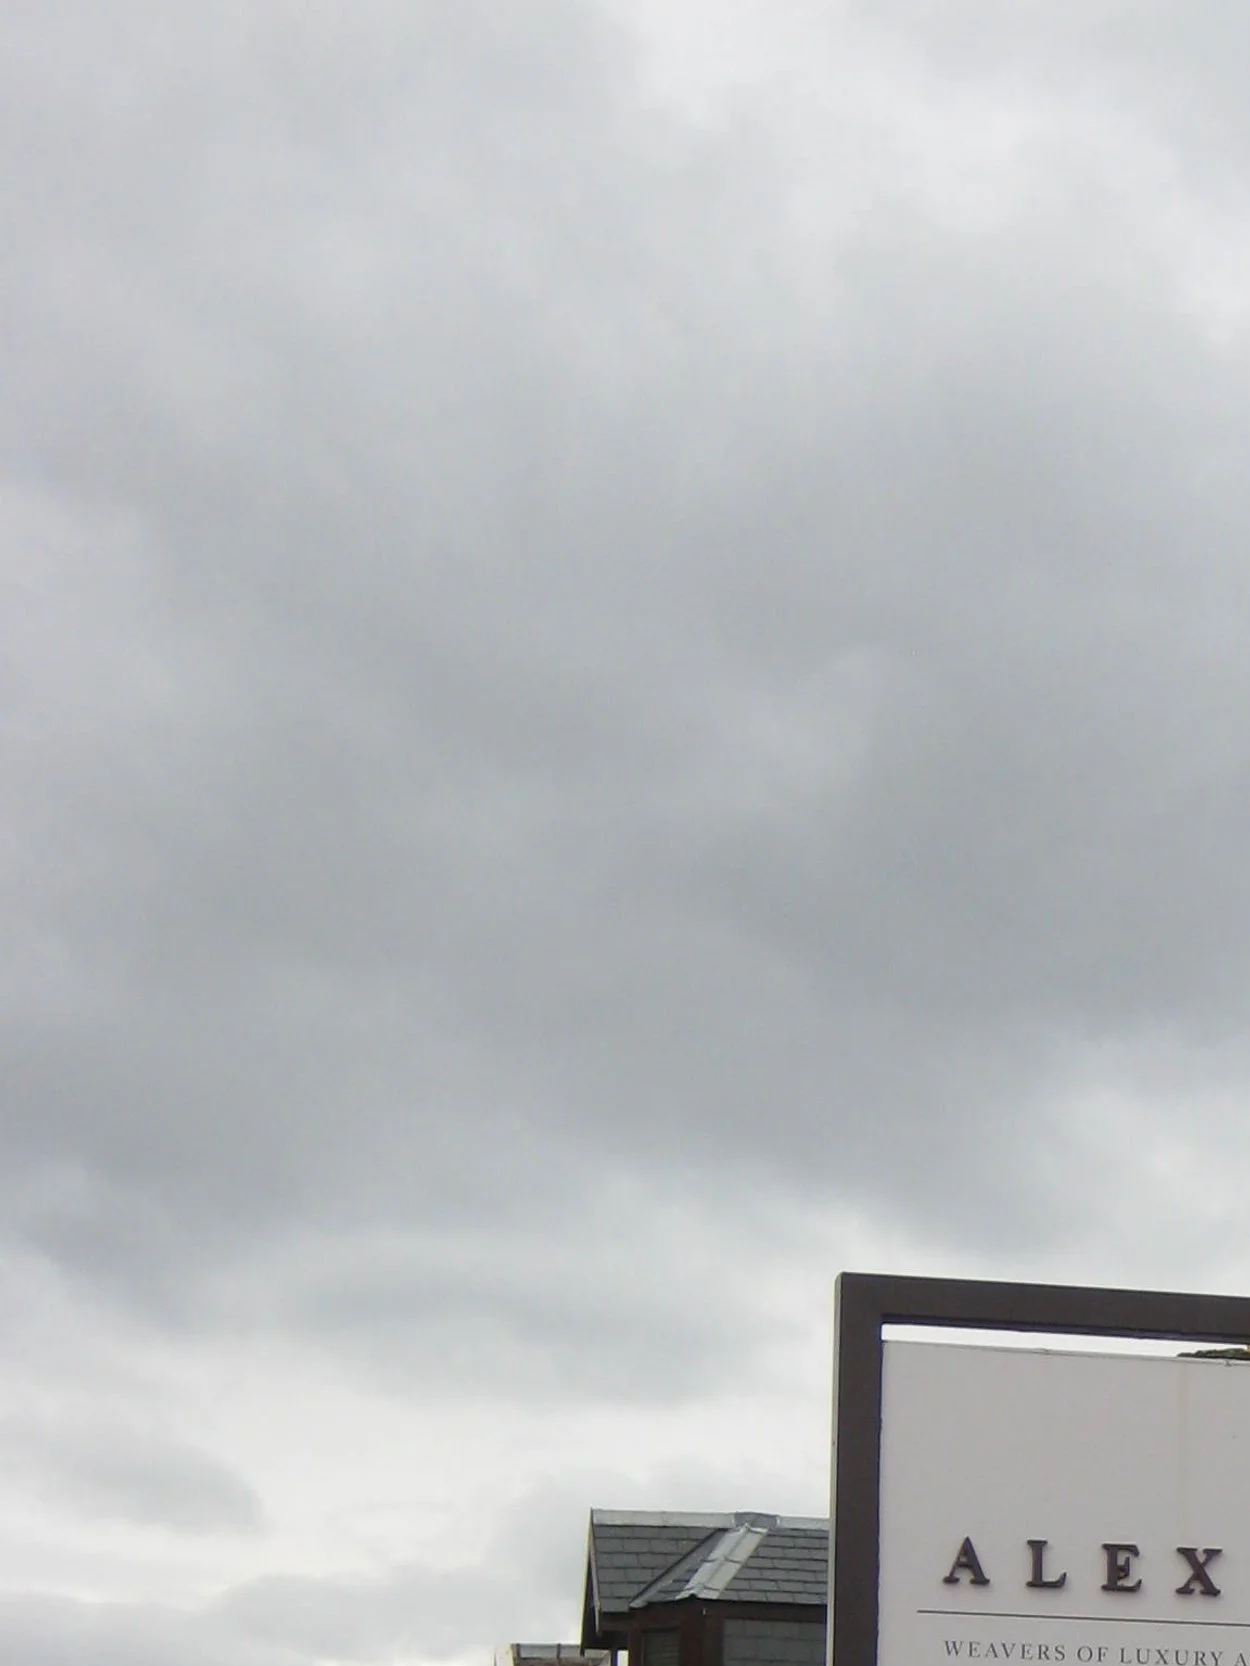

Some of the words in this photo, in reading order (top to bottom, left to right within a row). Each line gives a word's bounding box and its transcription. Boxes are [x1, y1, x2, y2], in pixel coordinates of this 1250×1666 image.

[943, 1536, 1223, 1597] ALEX
[944, 1640, 1066, 1662] WEAVERS
[1077, 1646, 1109, 1662] OF
